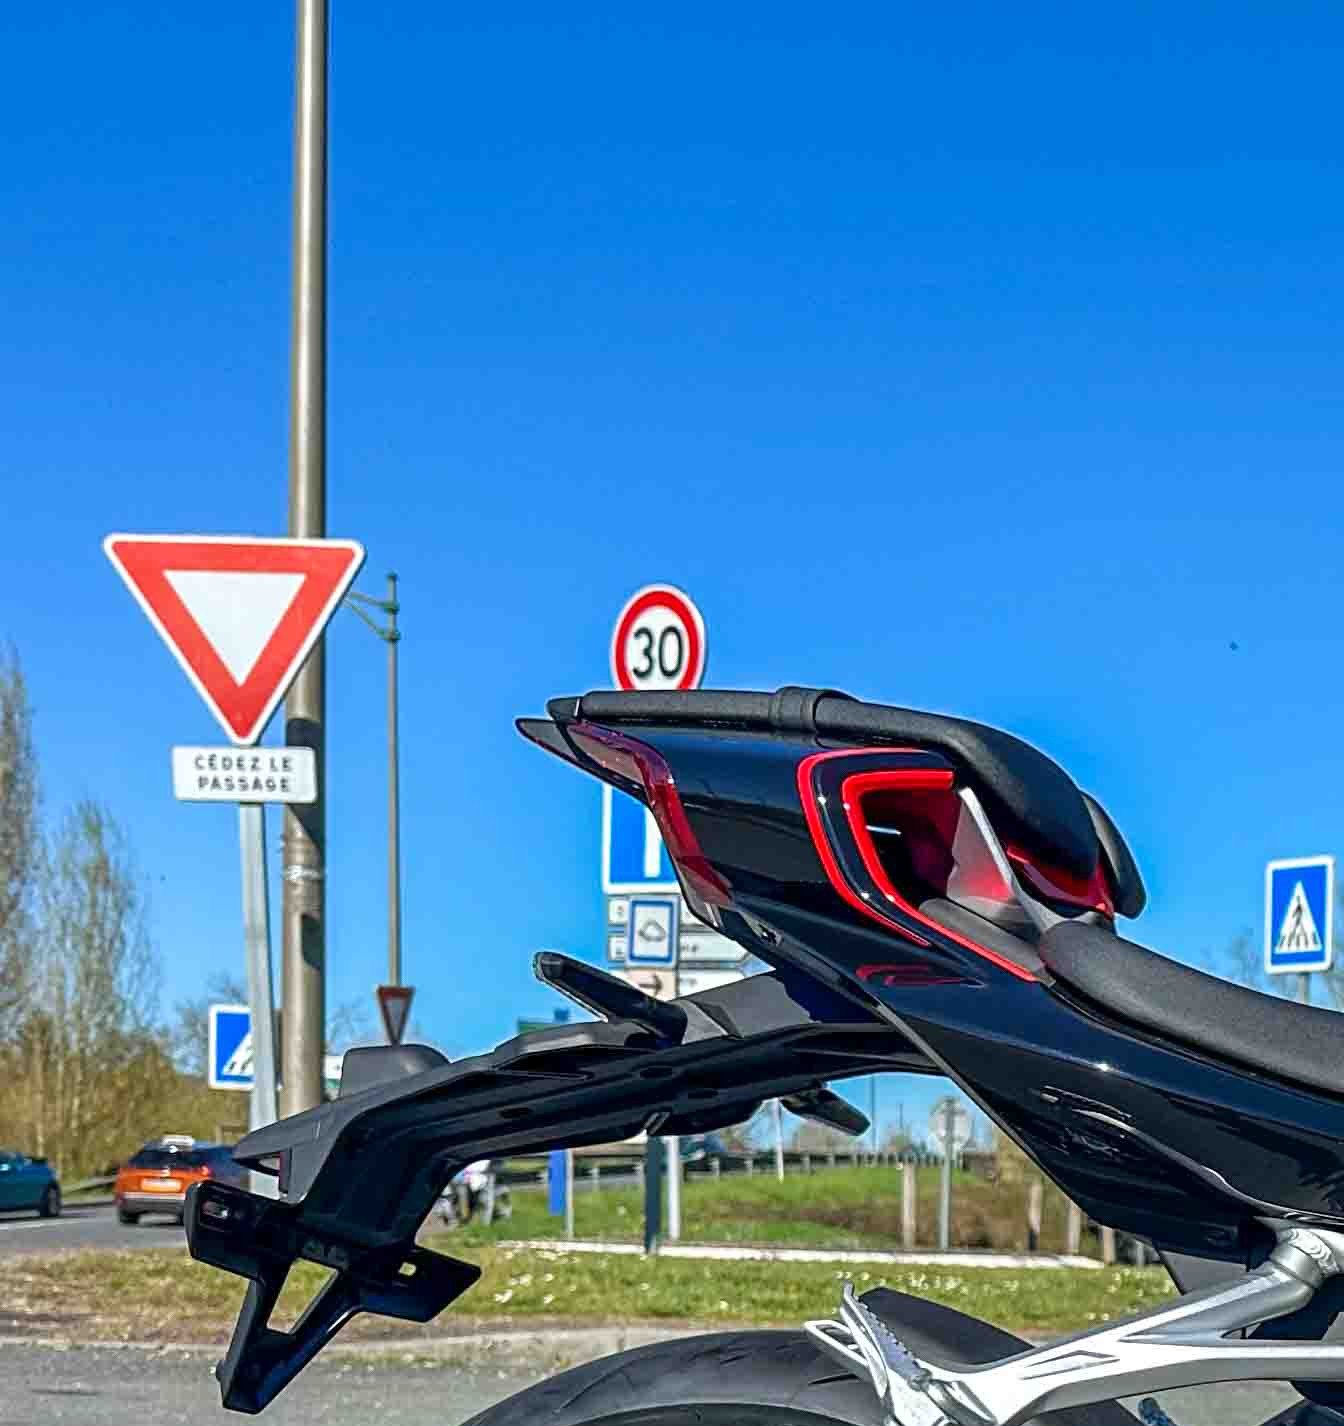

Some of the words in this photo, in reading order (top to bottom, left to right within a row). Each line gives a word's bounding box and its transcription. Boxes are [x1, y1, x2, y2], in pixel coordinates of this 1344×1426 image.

[633, 626, 684, 678] 30
[194, 754, 262, 771] CÉDEZ
[269, 757, 293, 772] LE
[197, 776, 291, 792] PASSAGE
